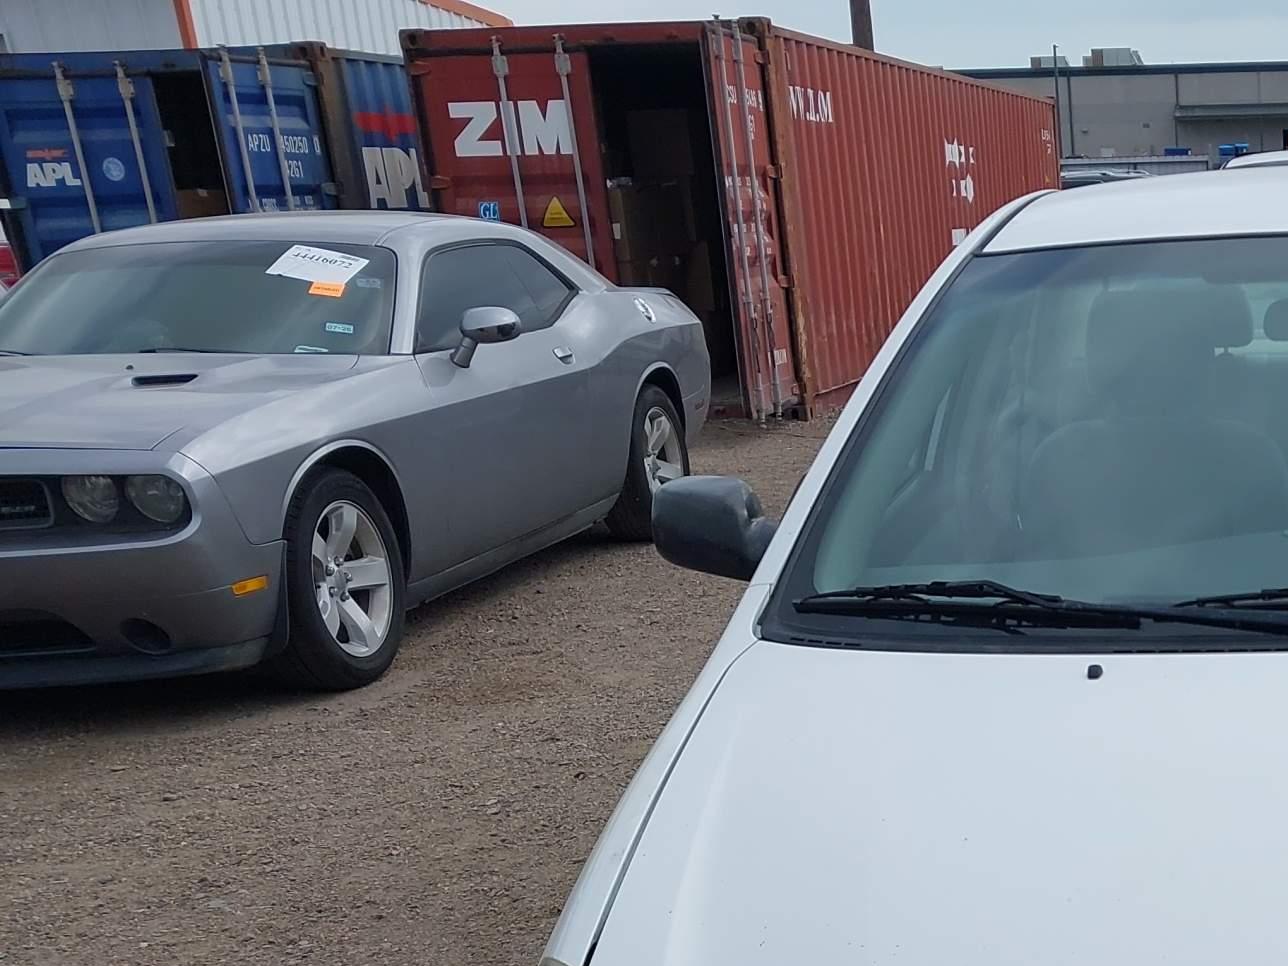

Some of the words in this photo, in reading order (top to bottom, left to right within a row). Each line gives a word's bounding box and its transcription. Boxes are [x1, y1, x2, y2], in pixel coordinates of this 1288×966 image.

[448, 100, 574, 157] ZIM
[248, 134, 271, 152] APZU
[26, 162, 82, 187] APL
[287, 160, 304, 178] 2G1
[362, 146, 431, 208] APL
